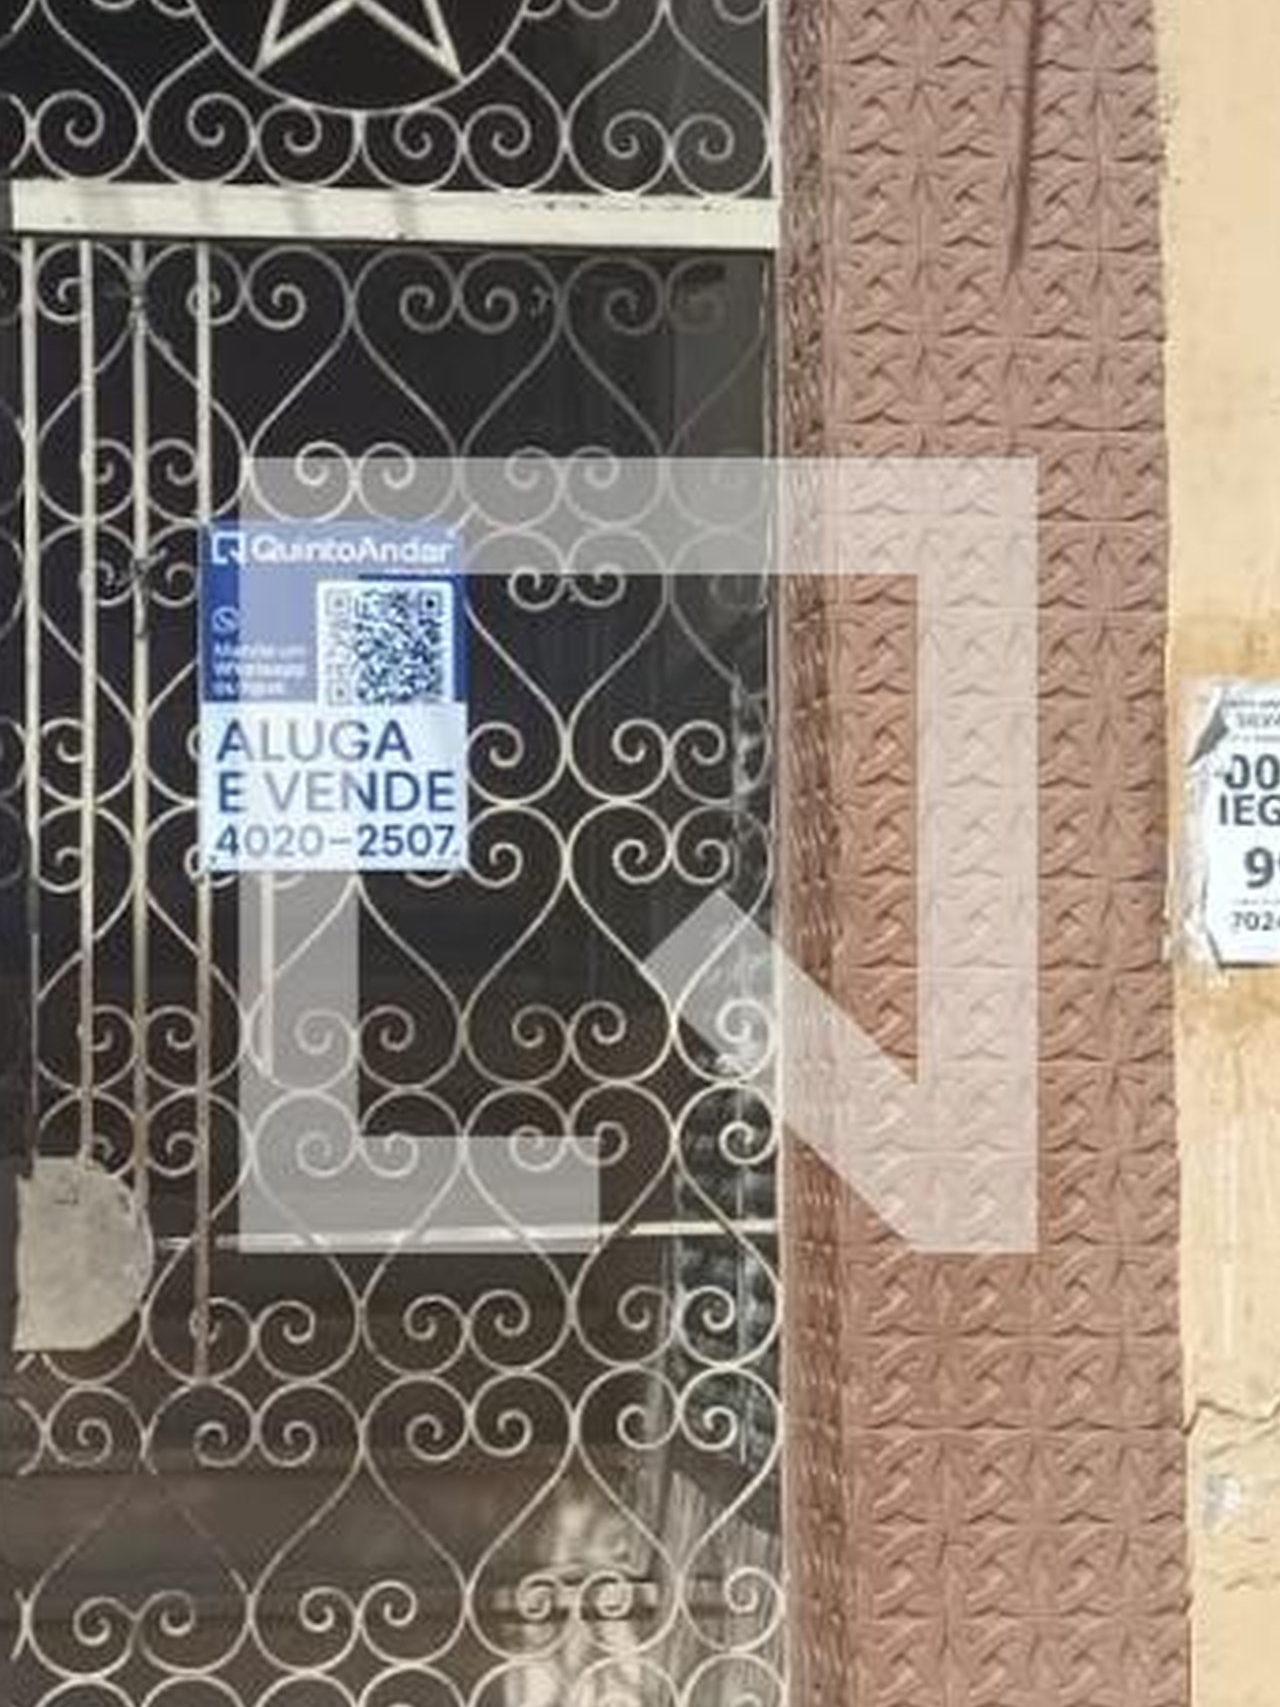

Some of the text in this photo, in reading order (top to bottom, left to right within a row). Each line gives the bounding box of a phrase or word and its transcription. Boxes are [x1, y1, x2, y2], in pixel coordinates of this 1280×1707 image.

[251, 533, 455, 565] QuintoAndar
[215, 719, 414, 762] ALUGA
[220, 770, 456, 812] E VENDE
[215, 823, 456, 858] 4020-2507
